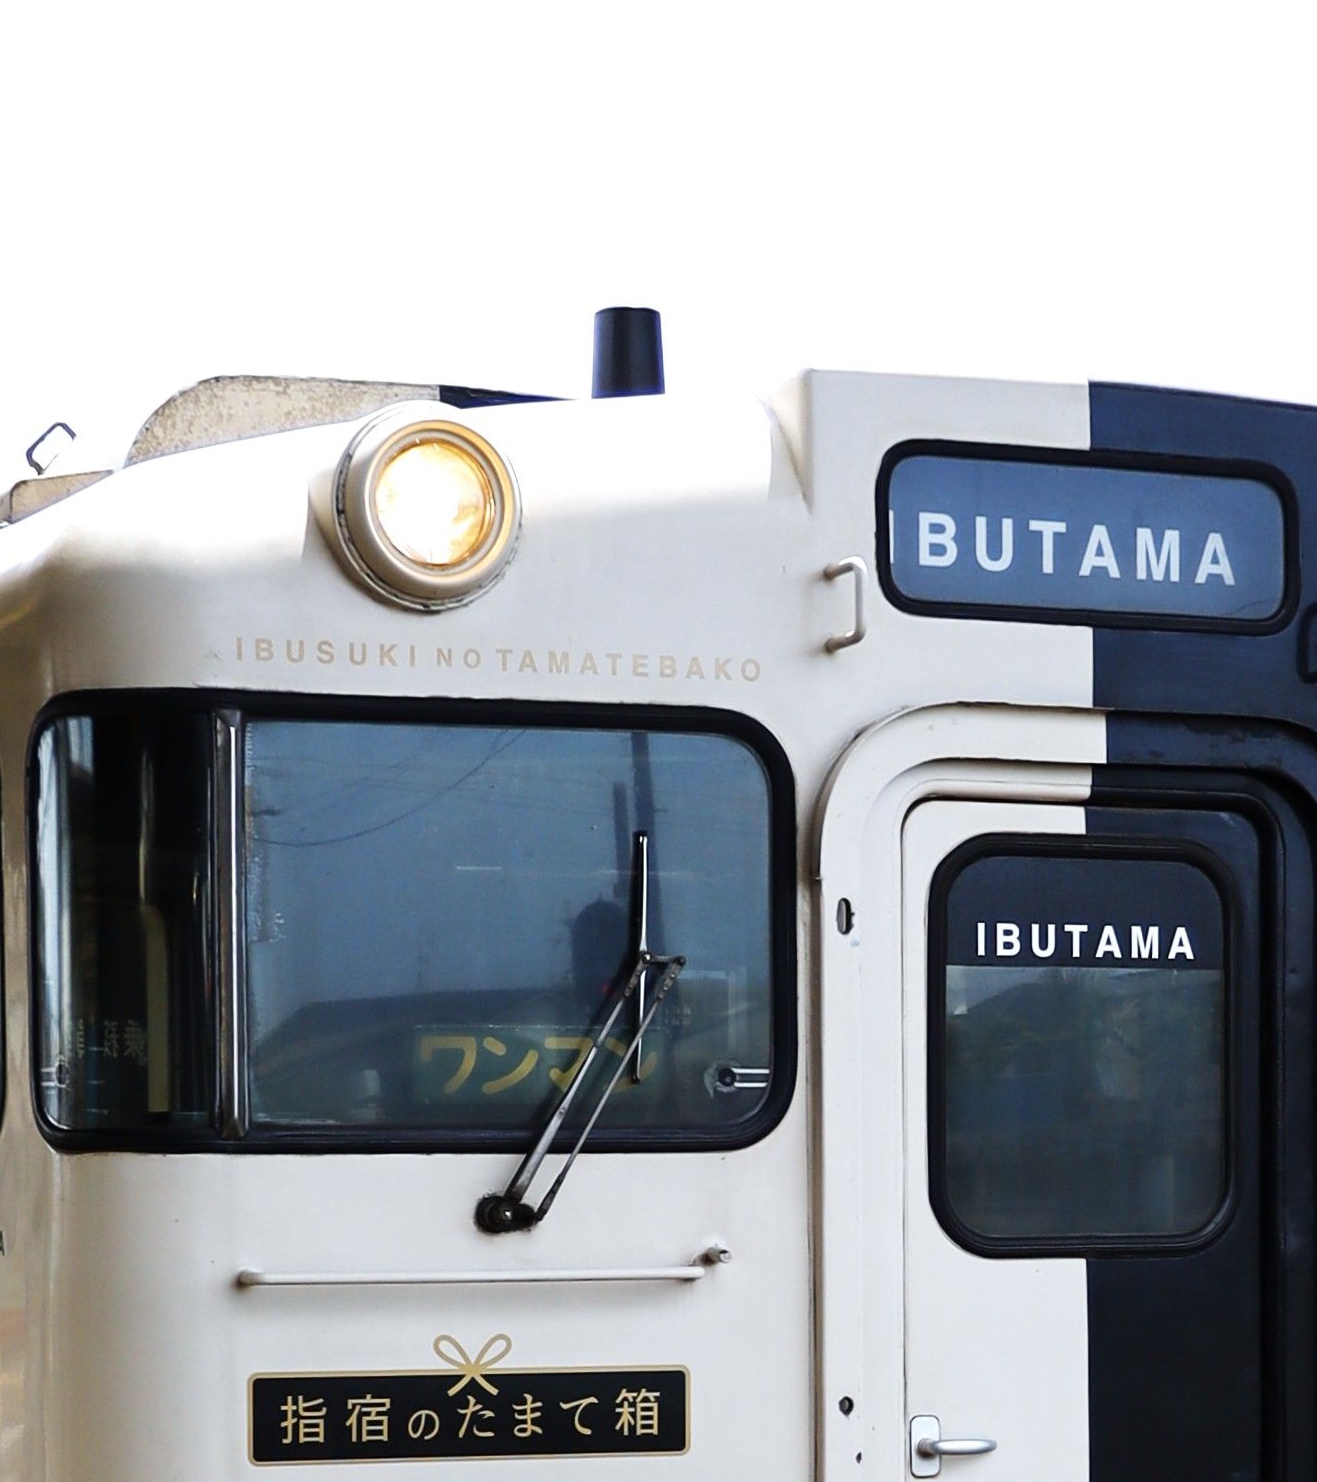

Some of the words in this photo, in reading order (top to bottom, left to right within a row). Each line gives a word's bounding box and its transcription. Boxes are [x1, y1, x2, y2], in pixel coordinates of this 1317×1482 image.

[236, 637, 415, 668] IBUSUKI
[437, 648, 481, 669] NO
[495, 648, 762, 682] TAMATEBAKO
[977, 922, 1195, 960] IBUTAMA
[420, 1036, 659, 1096] ワンマン
[280, 1388, 661, 1444] 指宿のたまて箱
